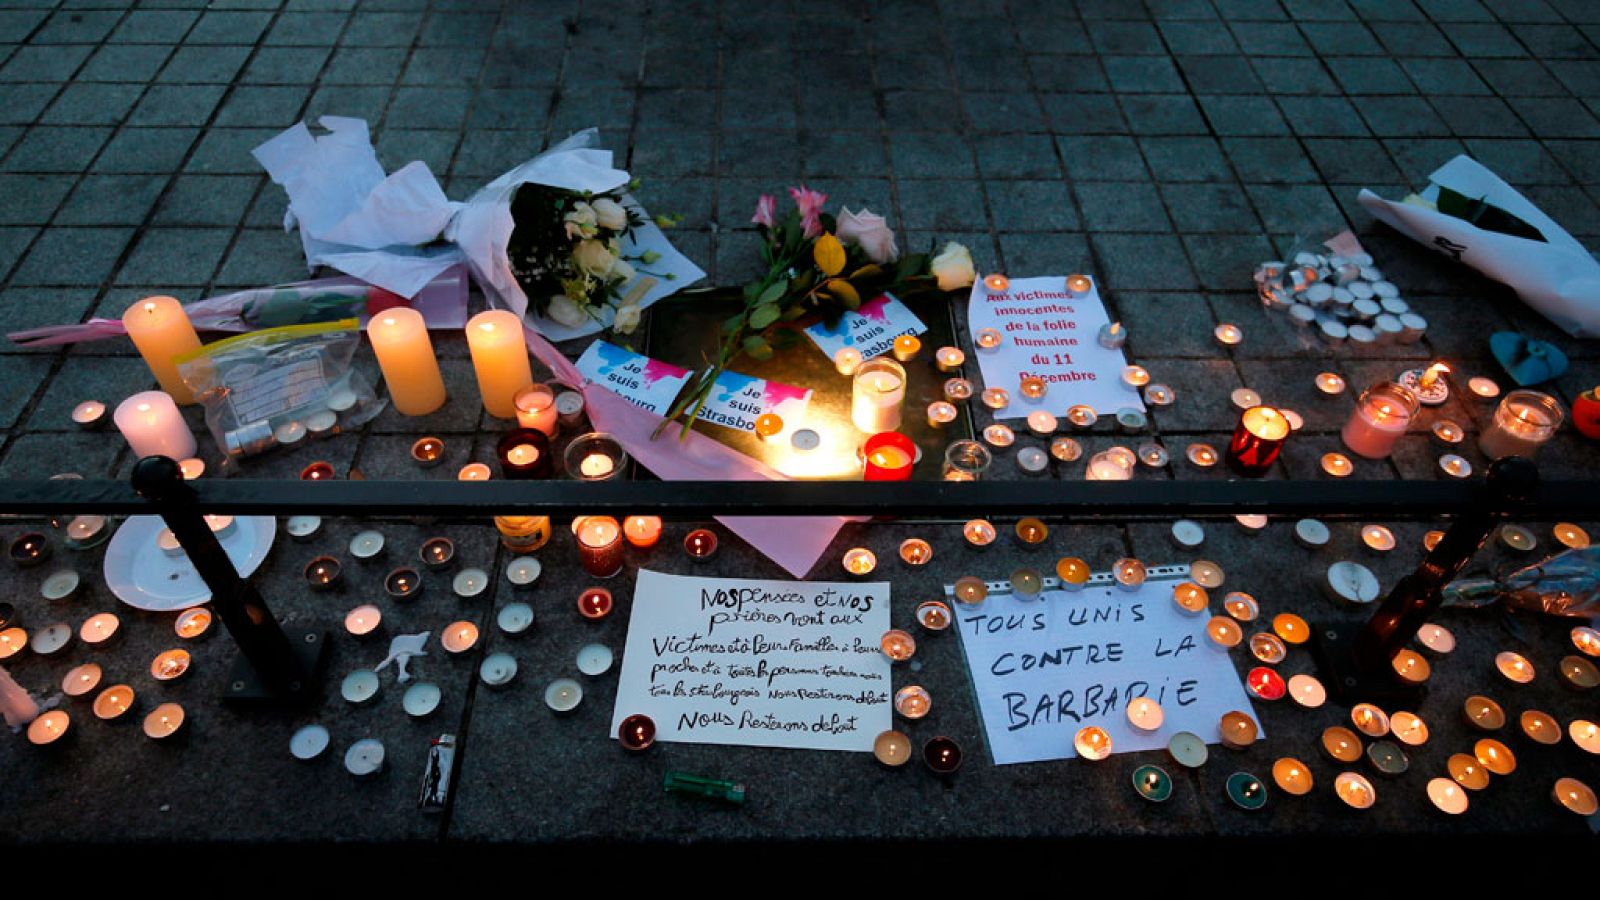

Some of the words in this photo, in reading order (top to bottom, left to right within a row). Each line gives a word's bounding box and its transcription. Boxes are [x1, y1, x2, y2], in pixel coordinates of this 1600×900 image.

[1014, 289, 1073, 301] victimes
[994, 303, 1075, 316] innocentes
[852, 318, 868, 330] Je
[1005, 321, 1024, 332] de
[1026, 320, 1040, 332] la
[1043, 319, 1076, 331] folie
[855, 326, 885, 343] suis
[1013, 335, 1078, 347] humaine
[1031, 353, 1050, 365] du
[1054, 353, 1073, 365] 11
[623, 363, 641, 375] Je
[607, 372, 640, 390] suis
[742, 387, 762, 399] Je
[728, 400, 762, 415] suis
[697, 406, 756, 431] Strasbo
[814, 587, 837, 607] et
[708, 608, 782, 637] prières
[830, 613, 863, 625] aux
[964, 613, 1045, 635] TOUS
[991, 643, 1124, 676] CONTRE
[1154, 634, 1197, 658] LA
